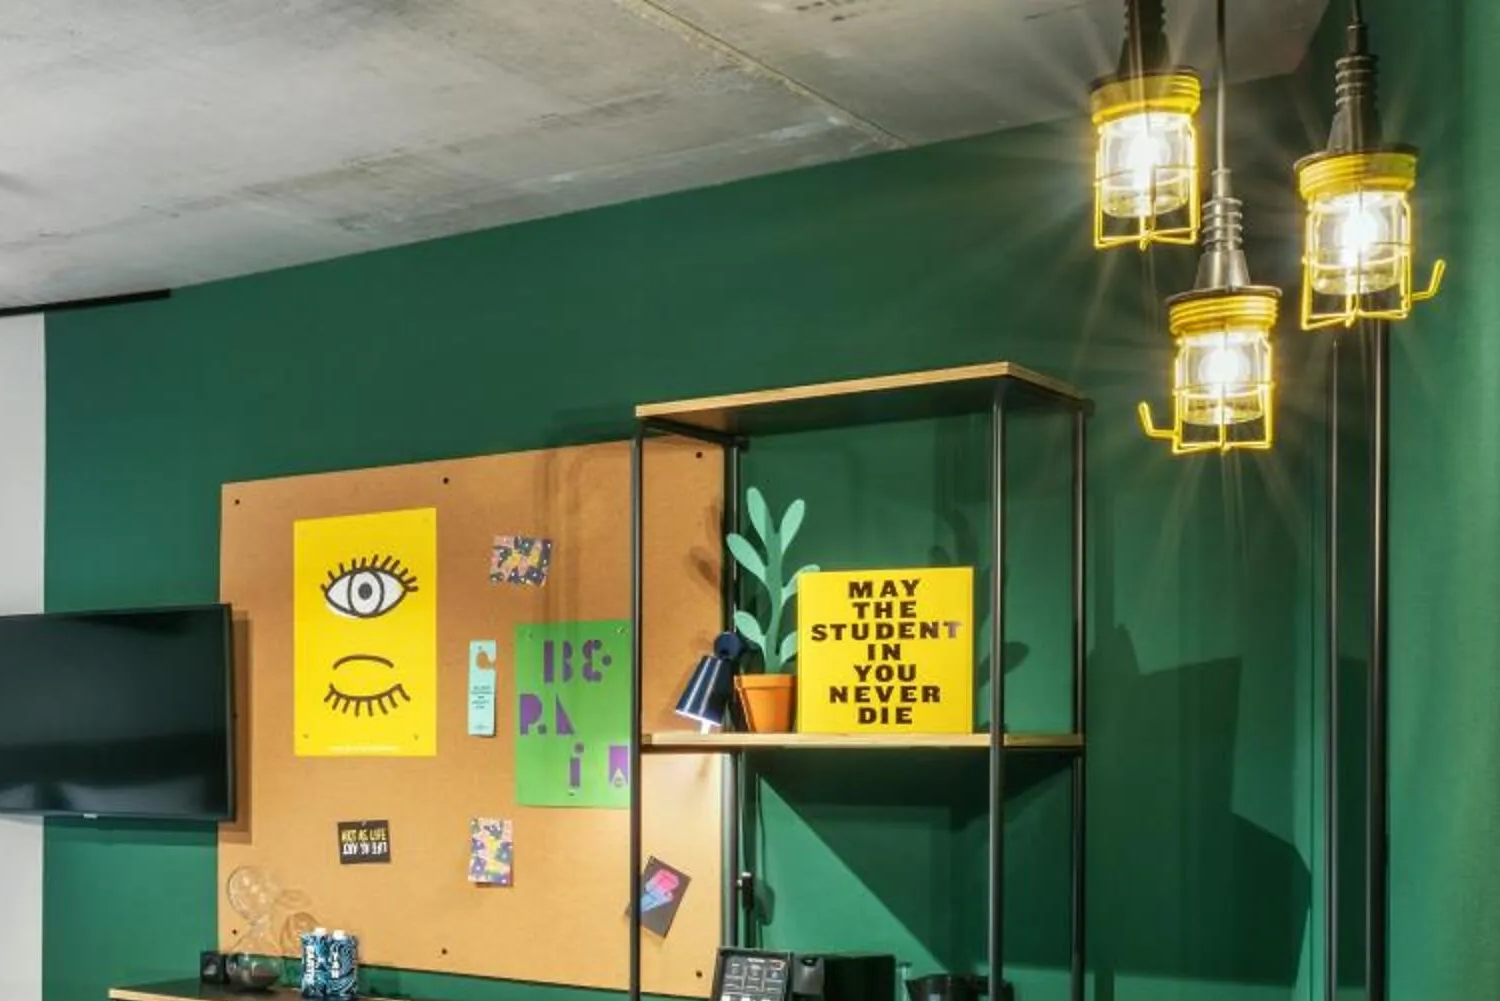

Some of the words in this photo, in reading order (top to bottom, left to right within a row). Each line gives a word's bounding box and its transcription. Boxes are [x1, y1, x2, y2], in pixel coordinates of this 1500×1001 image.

[848, 579, 920, 598] MAY
[853, 601, 917, 619] THE
[811, 621, 962, 641] STUDENT
[867, 644, 901, 661] IN
[853, 664, 917, 682] YOU
[829, 686, 941, 703] NEVER
[858, 707, 913, 724] DIE
